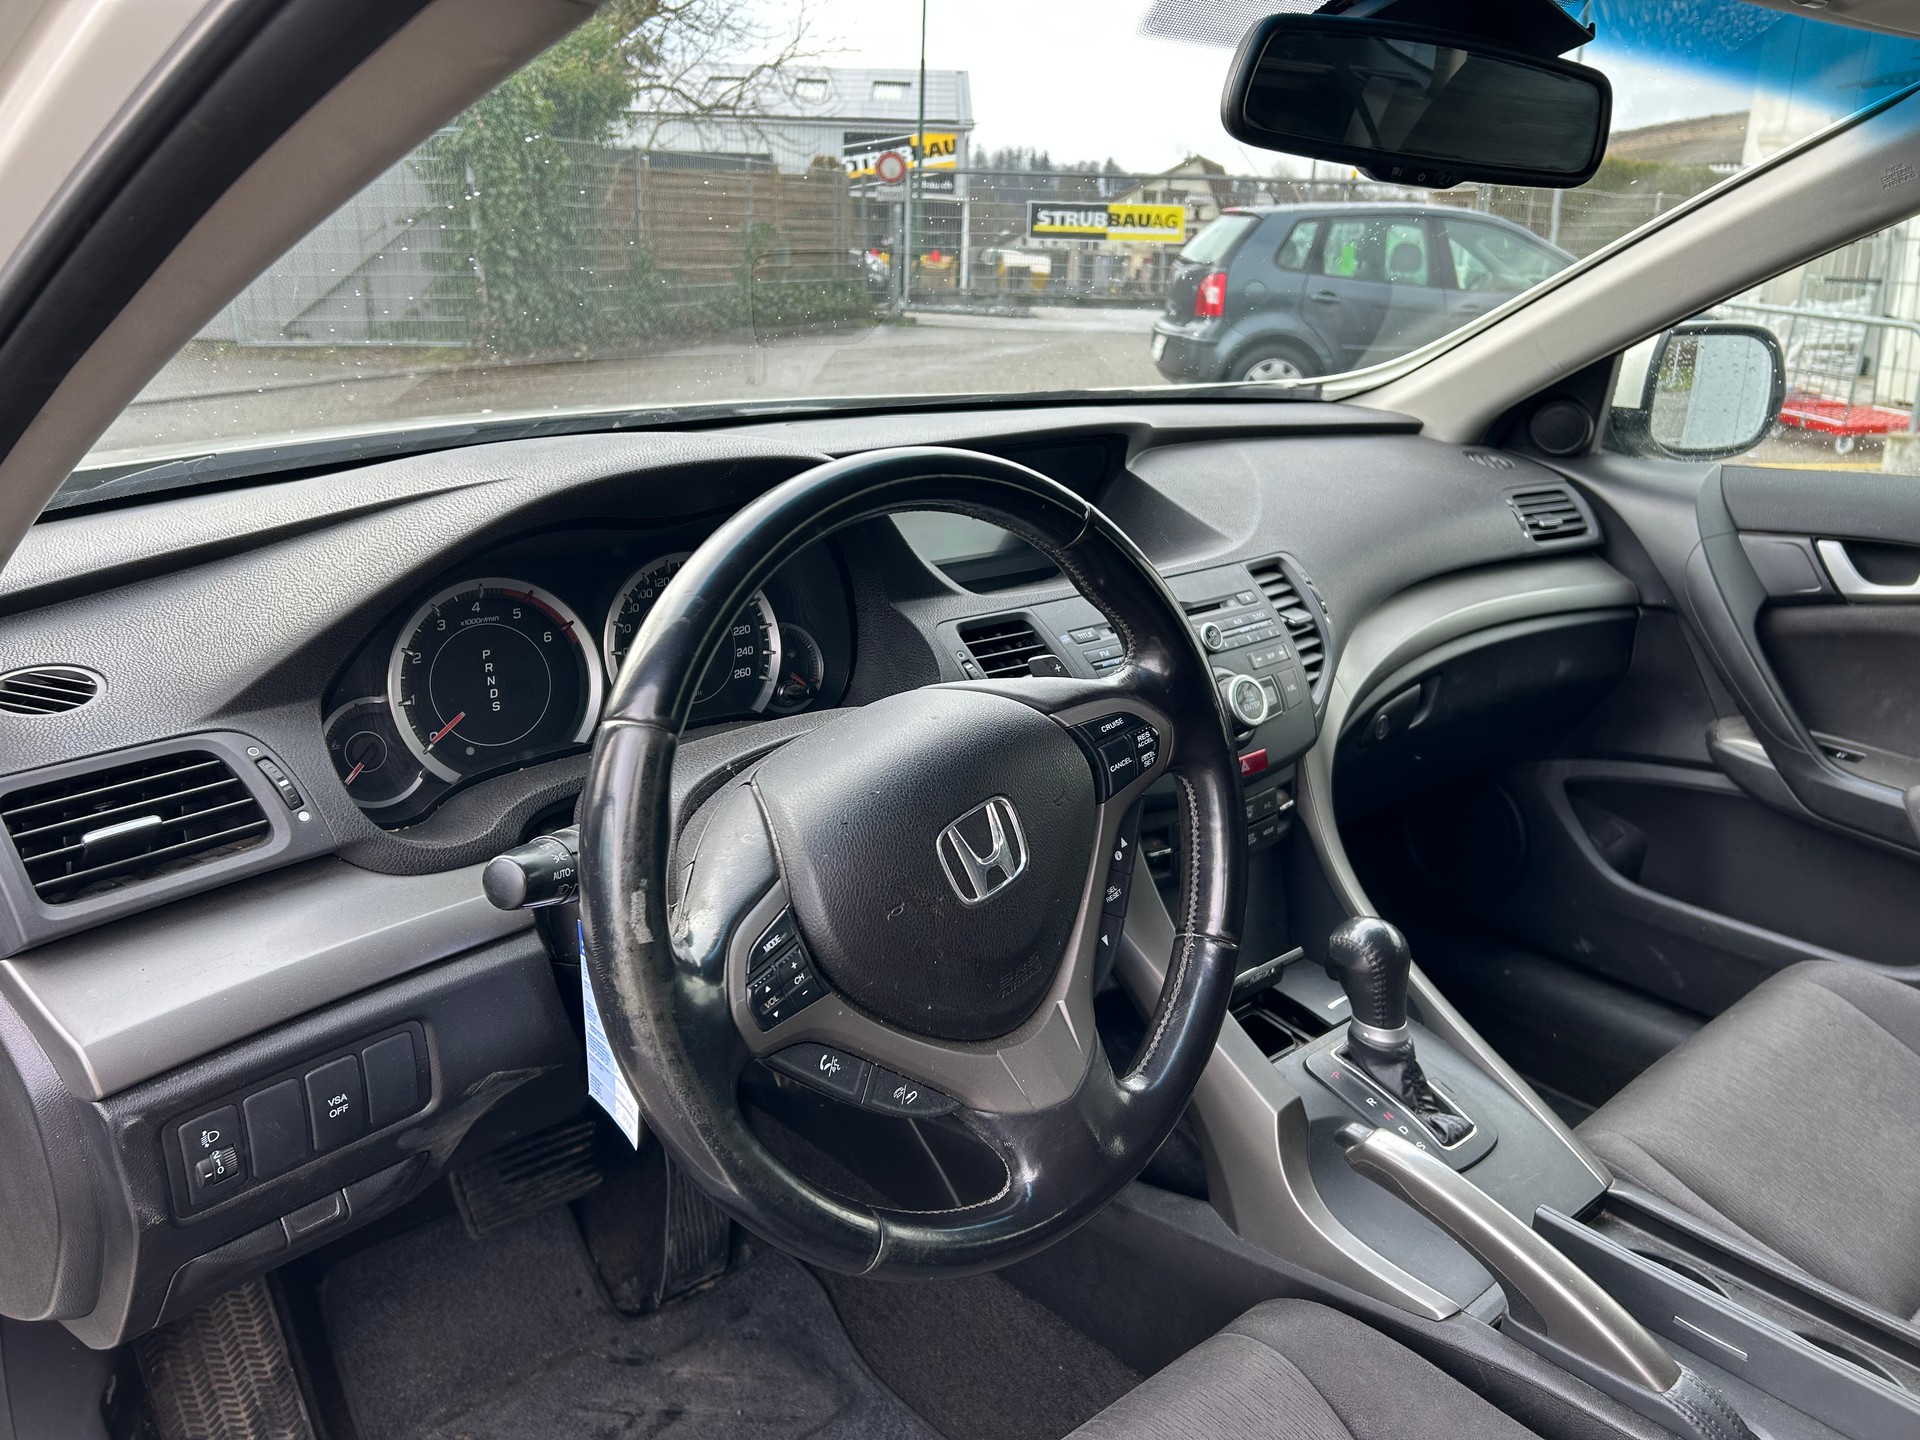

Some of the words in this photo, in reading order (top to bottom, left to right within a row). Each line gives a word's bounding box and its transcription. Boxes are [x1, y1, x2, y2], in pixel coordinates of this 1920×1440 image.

[471, 602, 480, 613] 4
[512, 608, 522, 620] 5
[436, 619, 447, 631] 3
[733, 624, 751, 637] 220
[542, 631, 553, 643] 6
[1077, 630, 1095, 641] TITLE
[482, 649, 491, 660] P
[736, 645, 754, 658] 240
[1099, 649, 1111, 659] FM
[412, 652, 422, 665] 2
[485, 662, 494, 673] R
[734, 667, 752, 680] 260
[487, 675, 496, 686] N
[489, 688, 499, 699] D
[491, 701, 501, 712] S
[1101, 717, 1125, 733] CRUISE
[1137, 731, 1151, 742] RES
[1137, 737, 1154, 749] ACCEL
[1110, 757, 1133, 773] CANCEL
[1143, 757, 1155, 768] SET
[553, 867, 571, 881] AUTO
[1107, 885, 1117, 895] SEL
[1105, 888, 1122, 904] RESET
[762, 934, 782, 953] MODE
[794, 972, 805, 985] CH
[764, 996, 780, 1009] VOL
[327, 1093, 348, 1107] VSA
[1365, 1097, 1378, 1107] R
[329, 1104, 349, 1118] OFF
[1398, 1125, 1409, 1136] D
[1415, 1141, 1427, 1150] S
[212, 1150, 221, 1159] 2
[215, 1159, 222, 1168] 1
[217, 1166, 225, 1175] 0
